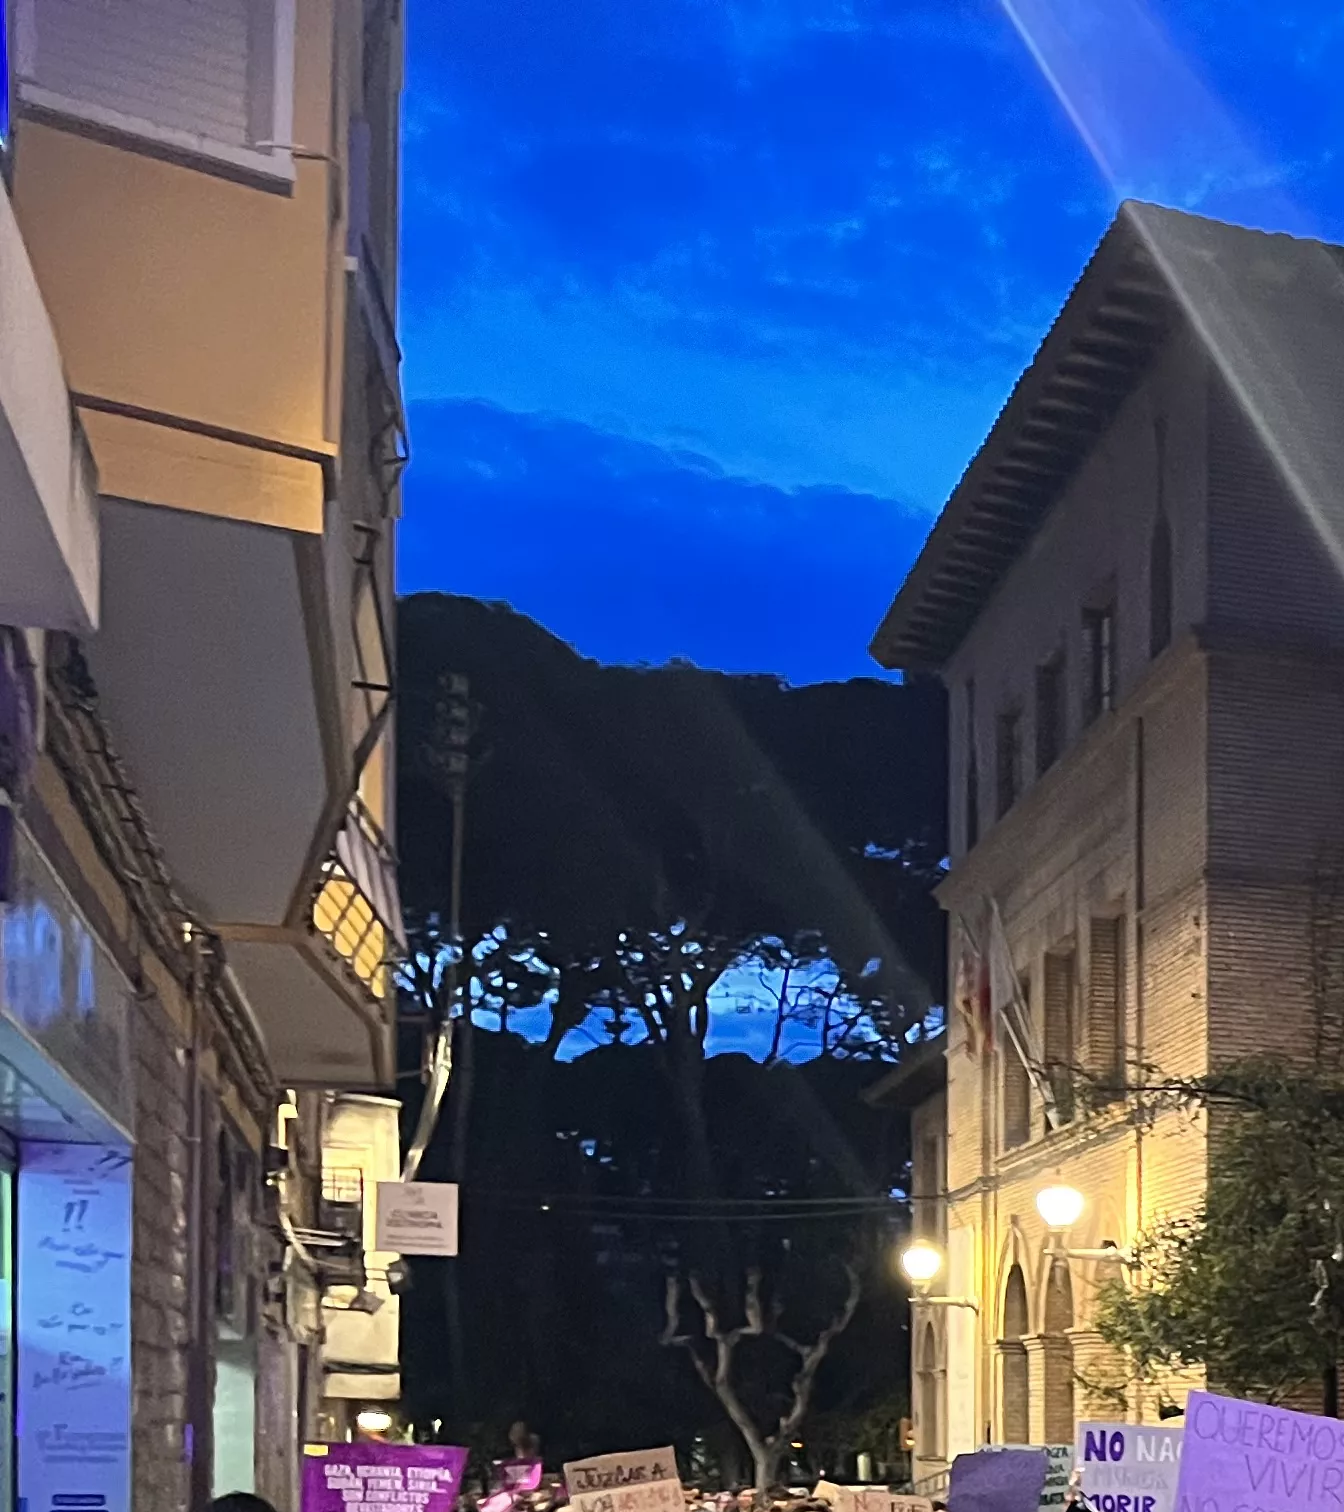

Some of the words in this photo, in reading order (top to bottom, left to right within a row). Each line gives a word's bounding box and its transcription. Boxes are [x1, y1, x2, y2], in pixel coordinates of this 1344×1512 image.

[1084, 1430, 1125, 1462] NO
[1136, 1434, 1184, 1463] NA
[1244, 1454, 1344, 1504] VIVIR
